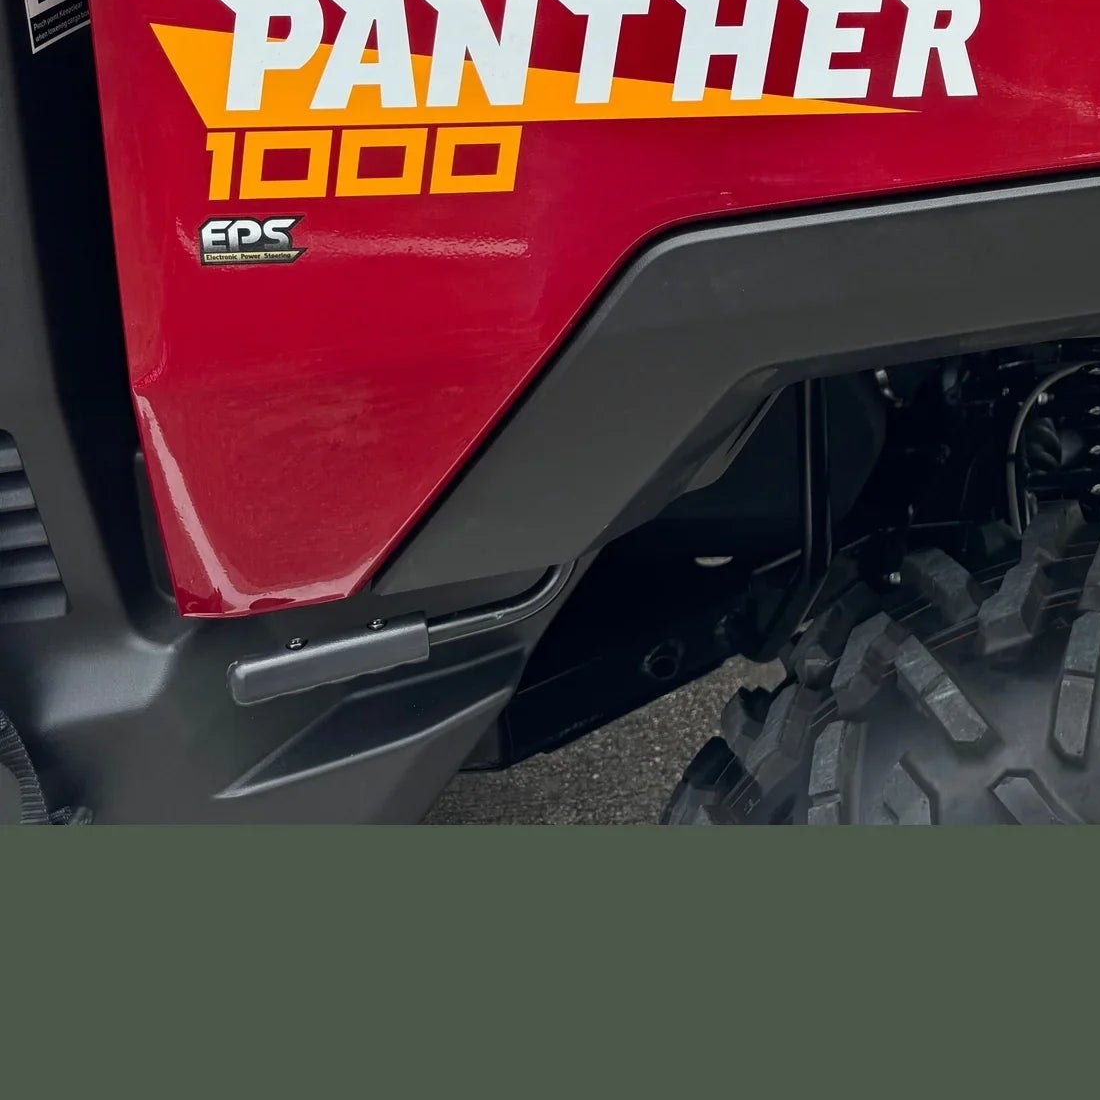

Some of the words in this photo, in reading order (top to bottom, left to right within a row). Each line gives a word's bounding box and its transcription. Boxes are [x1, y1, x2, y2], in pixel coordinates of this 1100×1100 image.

[206, 126, 522, 201] 1000
[202, 219, 296, 252] EPS
[206, 253, 237, 261] Electronic
[241, 253, 260, 261] Power
[264, 252, 291, 260] Steering
